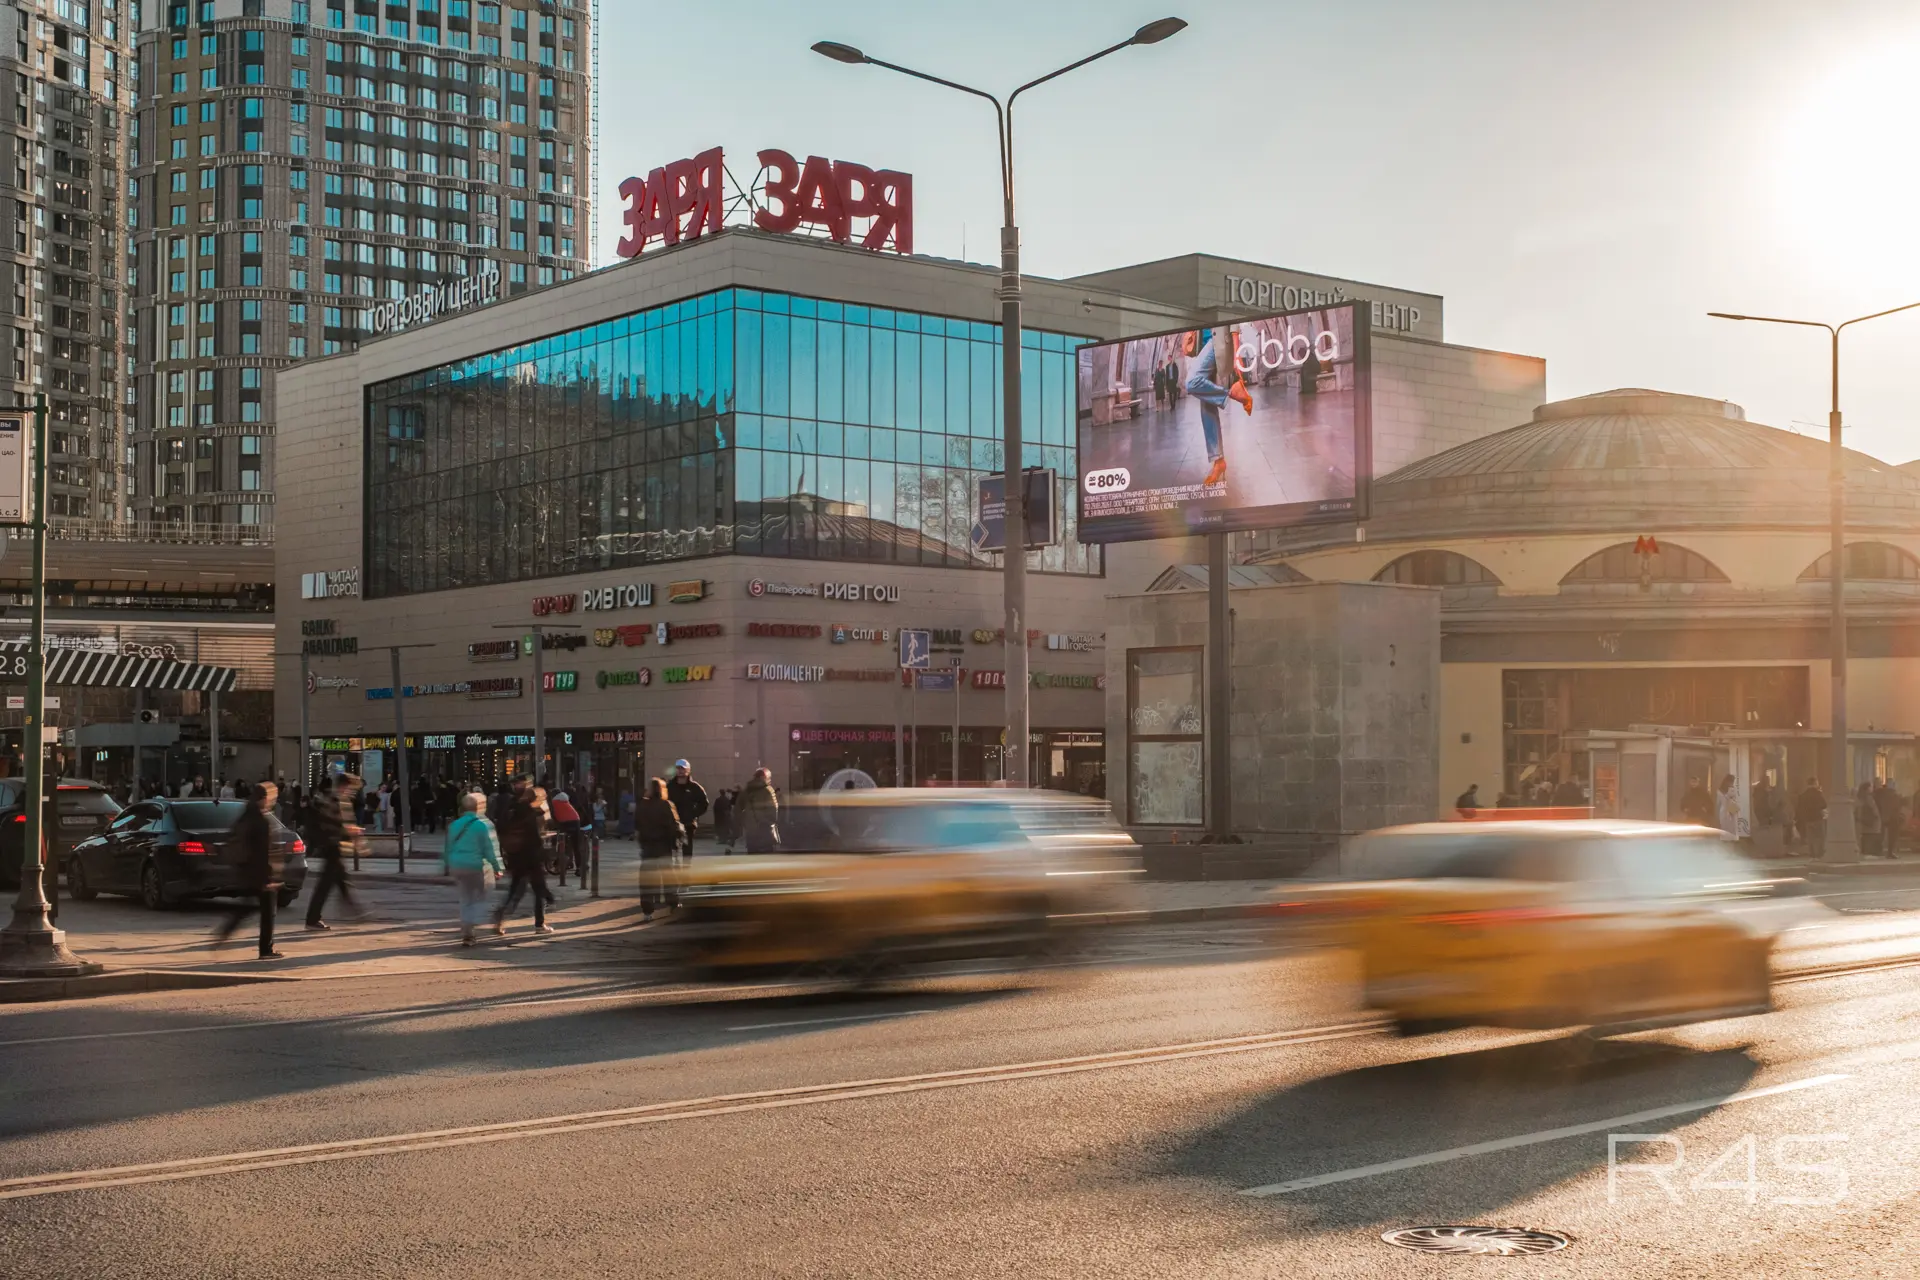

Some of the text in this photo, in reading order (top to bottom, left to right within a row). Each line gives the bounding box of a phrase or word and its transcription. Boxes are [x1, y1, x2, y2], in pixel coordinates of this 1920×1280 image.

[617, 146, 724, 258] ЗАРЯ
[754, 149, 913, 255] ЗАРЯ
[367, 268, 501, 333] ТОРГОВЫЙ ЦЕНТР
[1361, 298, 1421, 331] ЕНТР
[1235, 326, 1338, 373] obba
[328, 566, 359, 582] ЧИТАЙ
[328, 581, 359, 597] ГОРОД
[824, 582, 900, 602] РИВ ГОШ
[532, 593, 576, 616] МУ-МУ
[556, 672, 575, 688] ТУР
[763, 664, 824, 683] КОПИЦЕНТР
[1051, 674, 1094, 688] АПТЕКА
[321, 739, 349, 750] ТАБАК
[440, 735, 456, 749] COFFEE
[802, 729, 865, 743] ЦВЕТОЧНАЯ
[940, 731, 973, 743] ТААК
